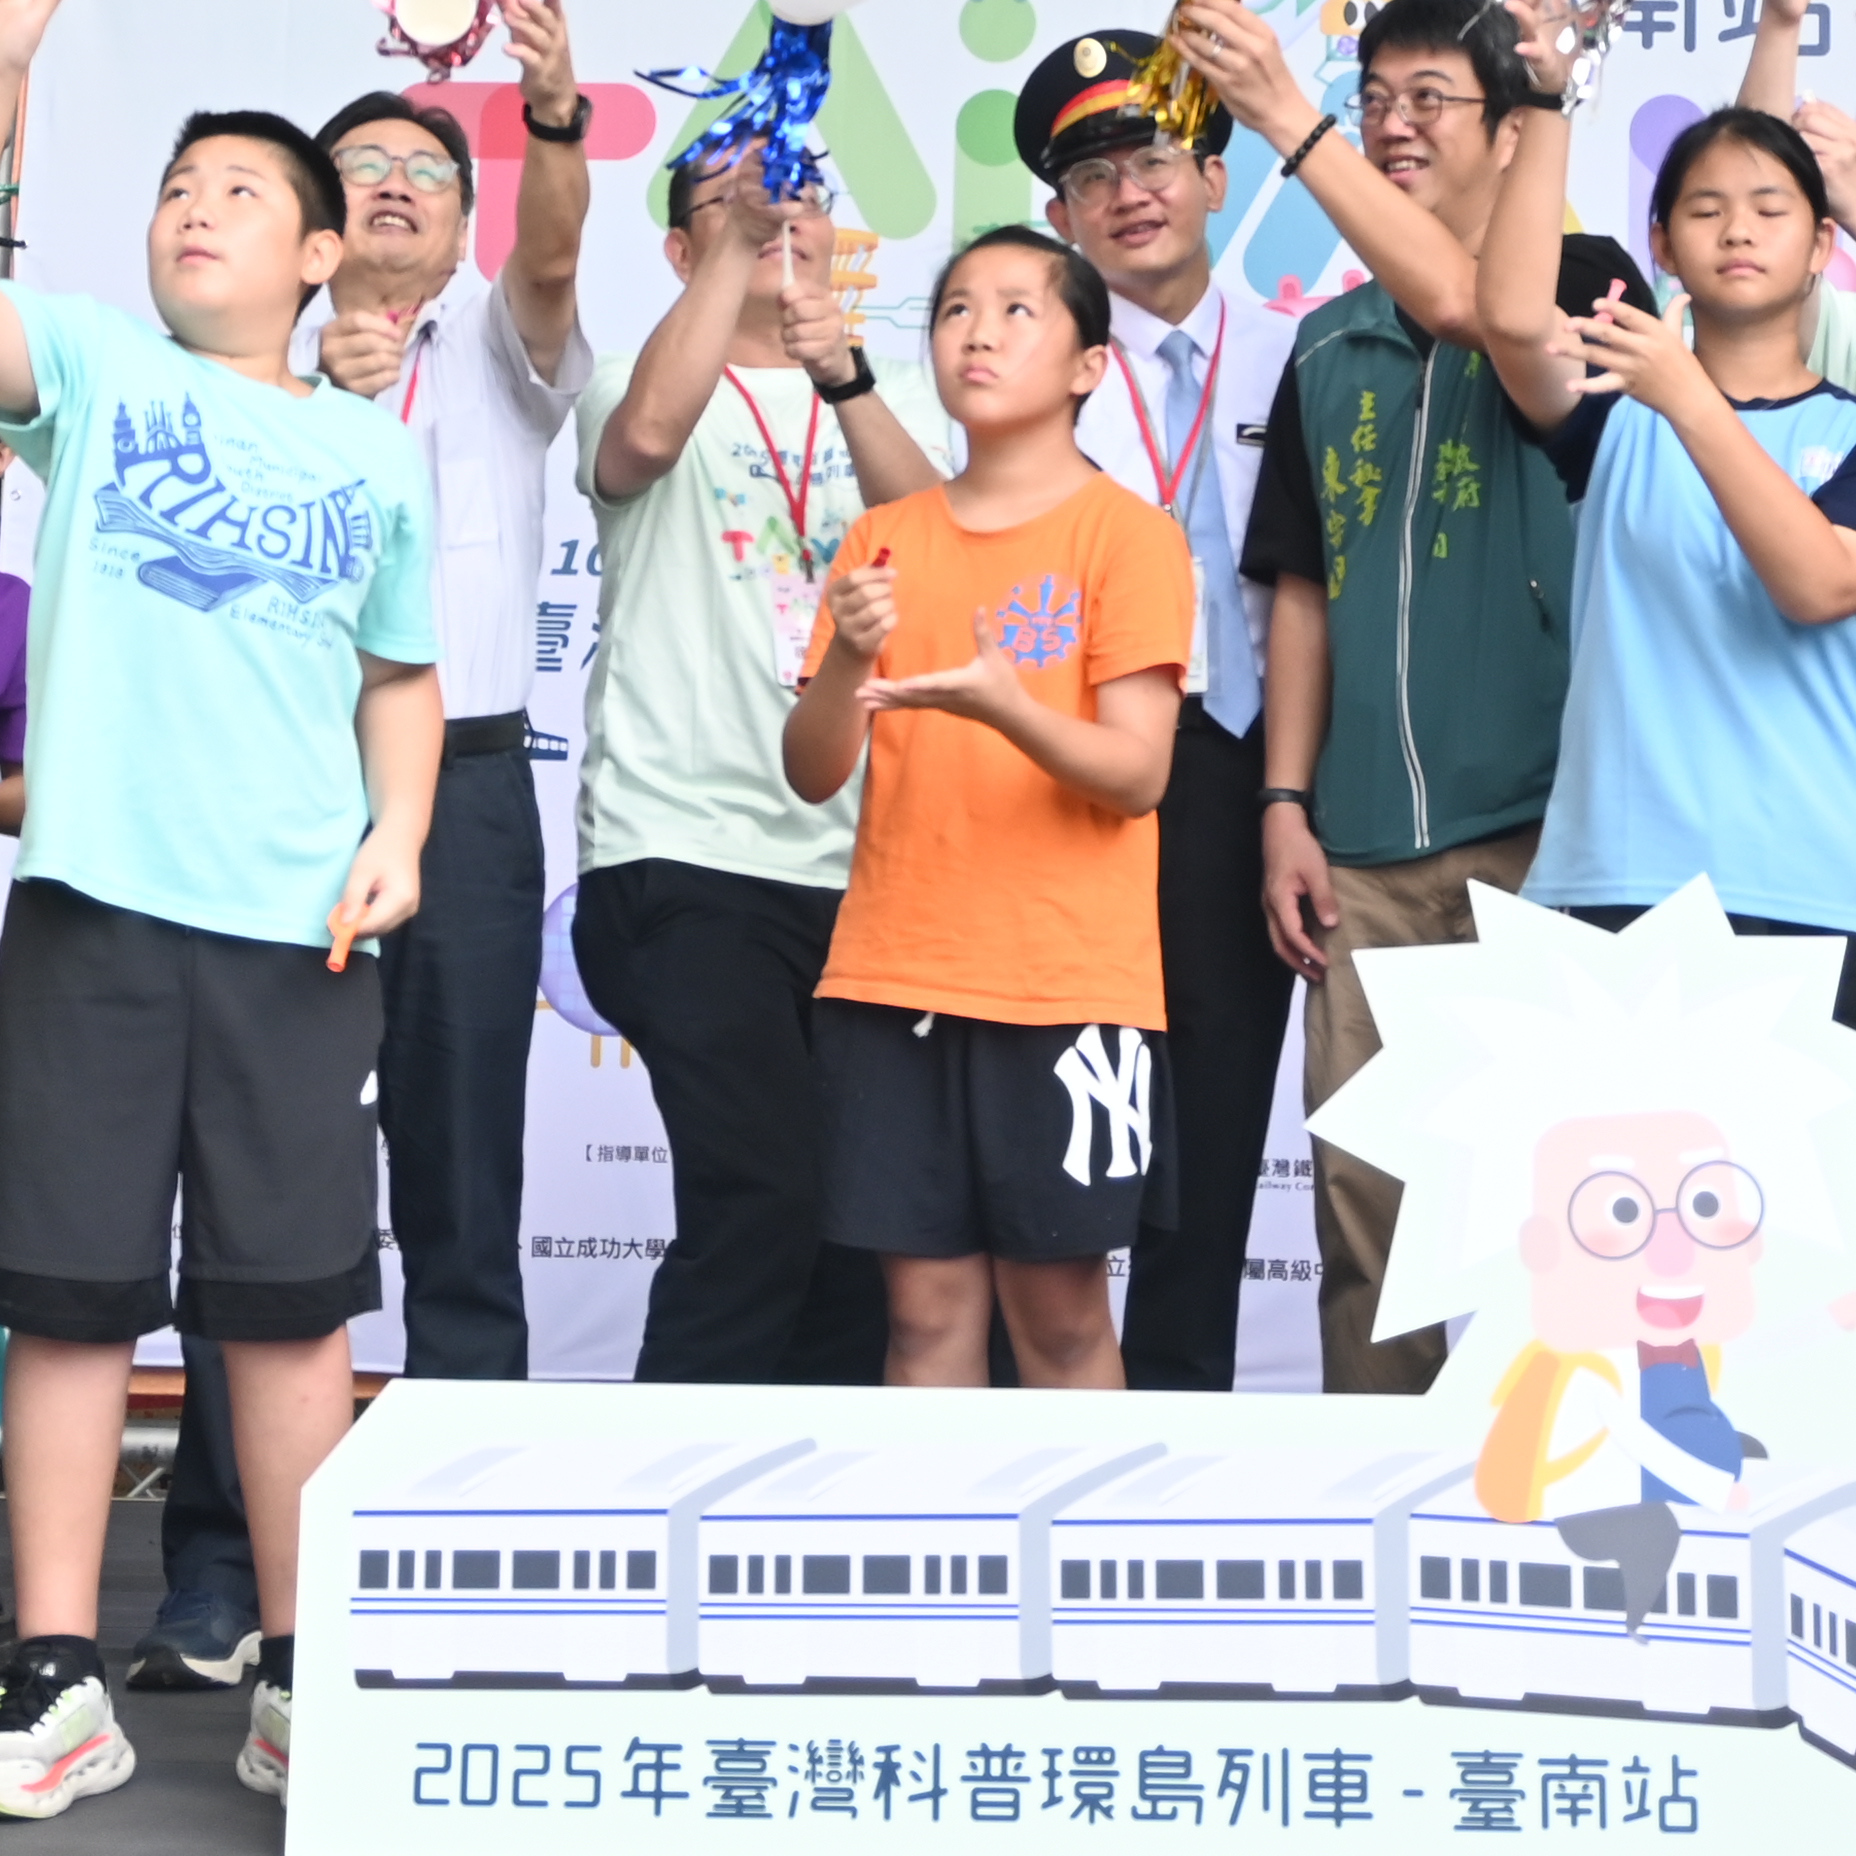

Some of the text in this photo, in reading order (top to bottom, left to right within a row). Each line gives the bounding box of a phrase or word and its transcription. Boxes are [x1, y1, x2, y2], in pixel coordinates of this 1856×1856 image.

[1256, 1180, 1293, 1192] ailway
[530, 1235, 666, 1261] 國立成功大學
[412, 1735, 1375, 1828] 2025年臺灣科普環島列車
[1448, 1748, 1700, 1834] 臺南站
